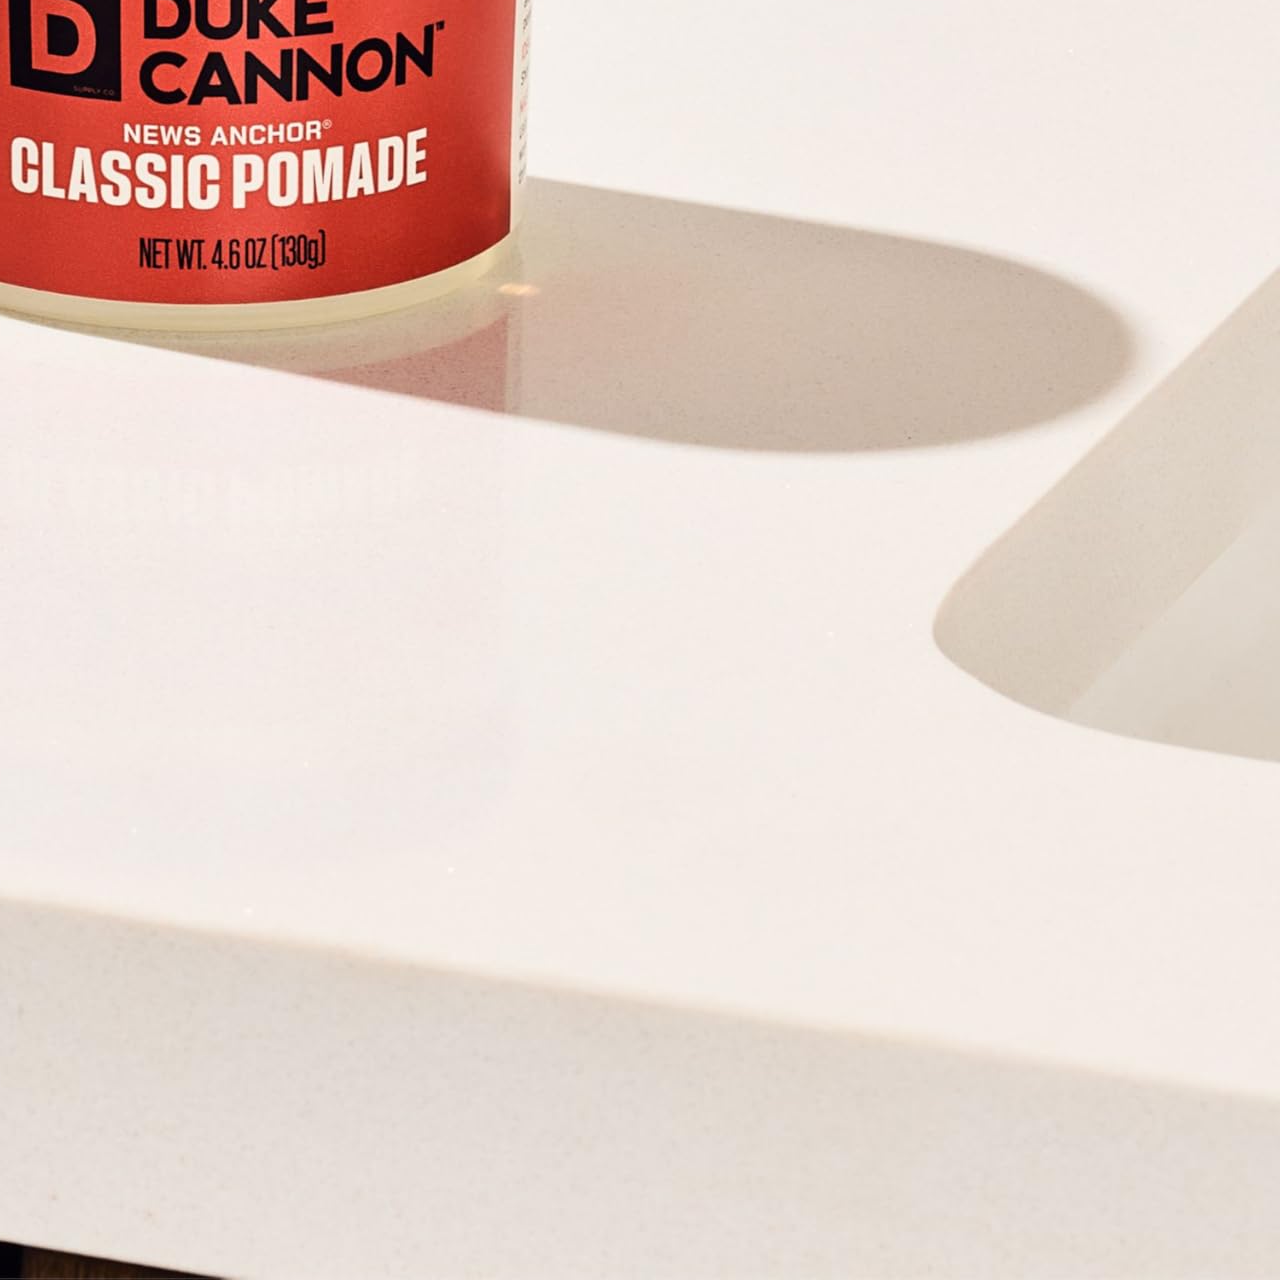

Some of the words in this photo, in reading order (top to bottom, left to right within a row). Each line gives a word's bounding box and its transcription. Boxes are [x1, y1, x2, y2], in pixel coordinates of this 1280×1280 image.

[123, 122, 202, 147] NEWS
[10, 136, 221, 211] CLASSIC
[231, 127, 428, 210] POMADE
[138, 237, 173, 269] NET
[176, 238, 207, 270] WT.
[210, 238, 240, 270] 4.6
[244, 237, 267, 269] OZ
